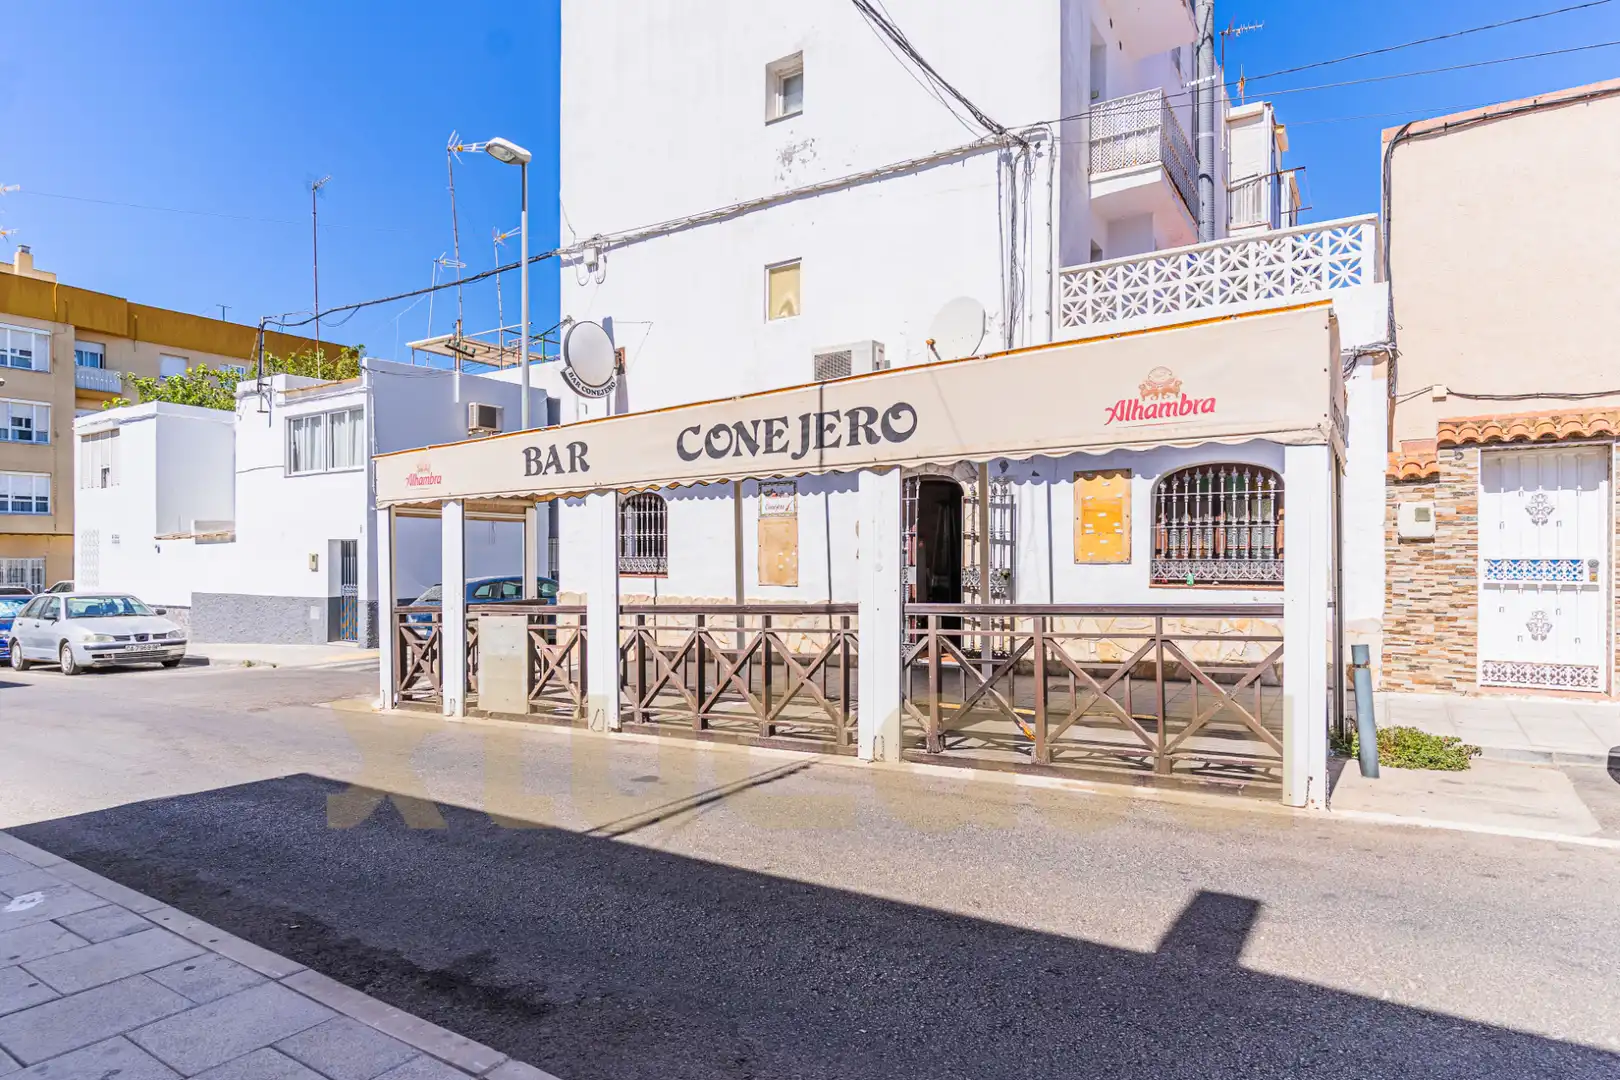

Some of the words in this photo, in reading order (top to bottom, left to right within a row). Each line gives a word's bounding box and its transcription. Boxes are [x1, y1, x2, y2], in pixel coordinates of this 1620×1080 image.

[568, 371, 581, 388] BAR
[581, 381, 616, 396] CONEJERO
[1104, 392, 1216, 426] Alhambra
[522, 441, 590, 477] BAR
[676, 402, 918, 462] CONEJERO
[404, 471, 442, 488] Alhambra
